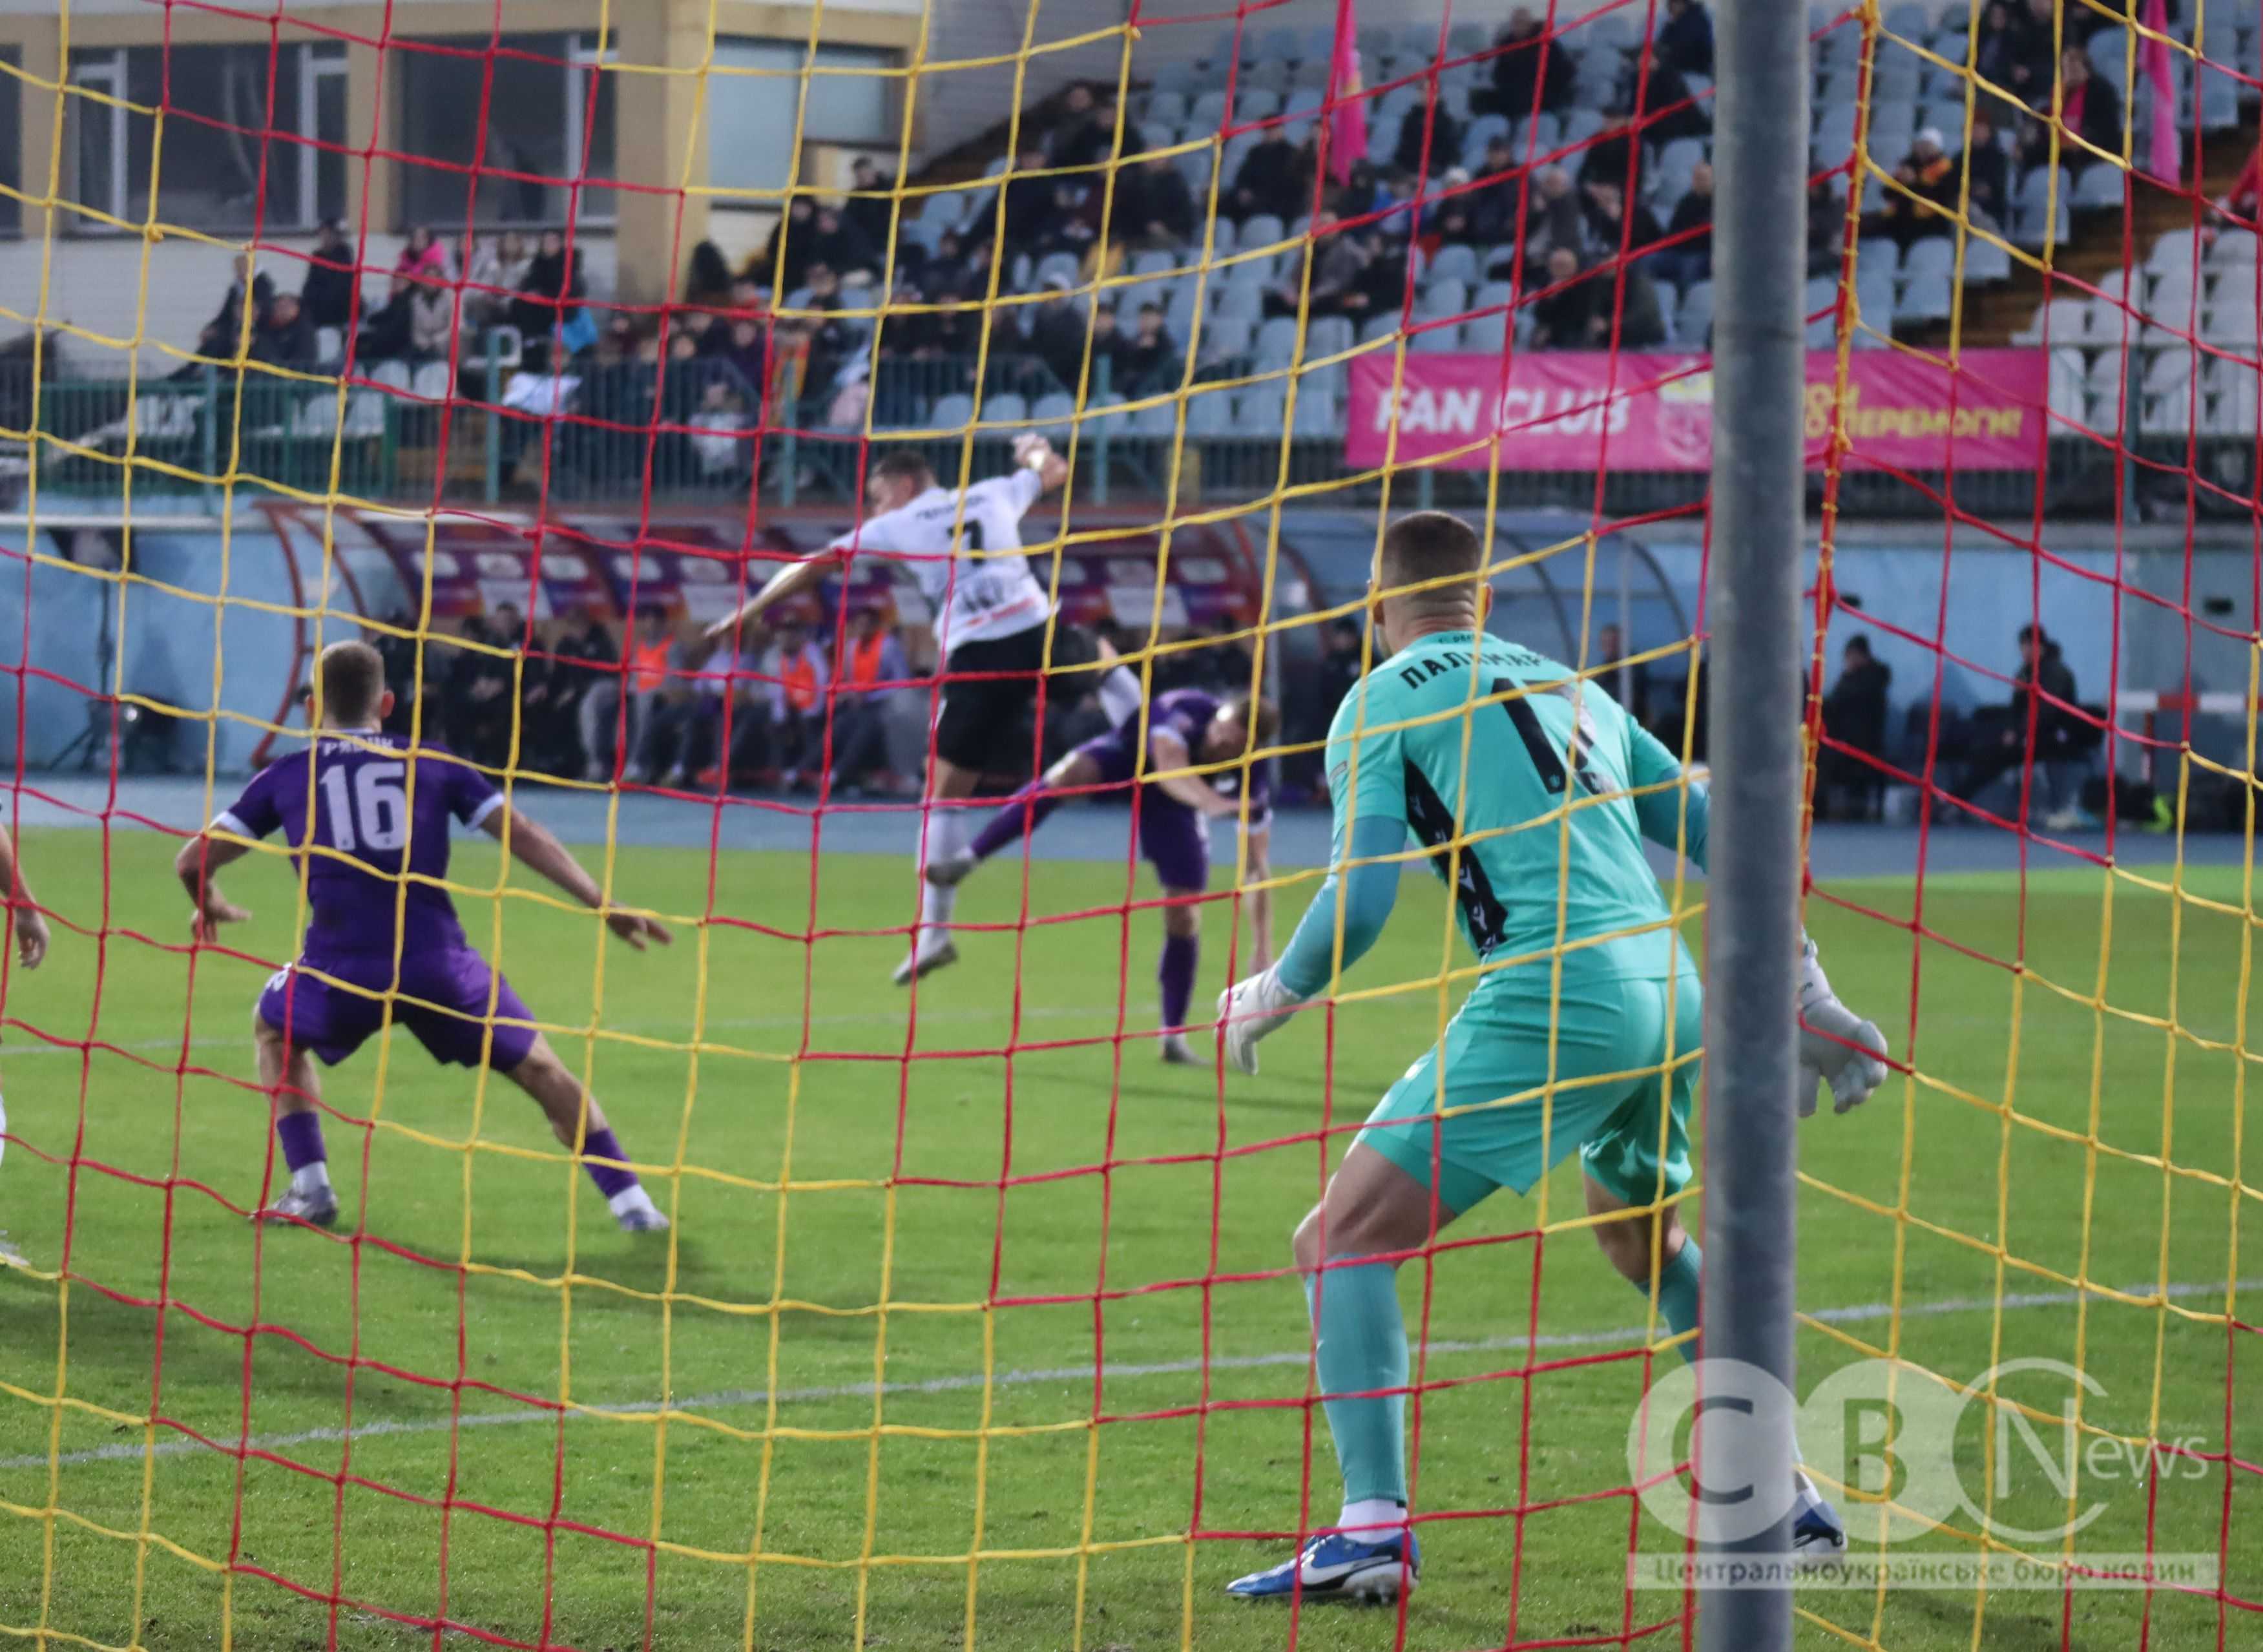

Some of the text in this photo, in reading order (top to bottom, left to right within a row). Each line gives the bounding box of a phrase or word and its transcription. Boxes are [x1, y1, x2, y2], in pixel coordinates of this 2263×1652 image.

[1376, 390, 1632, 435] FAN CLUB
[320, 762, 407, 850] 16
